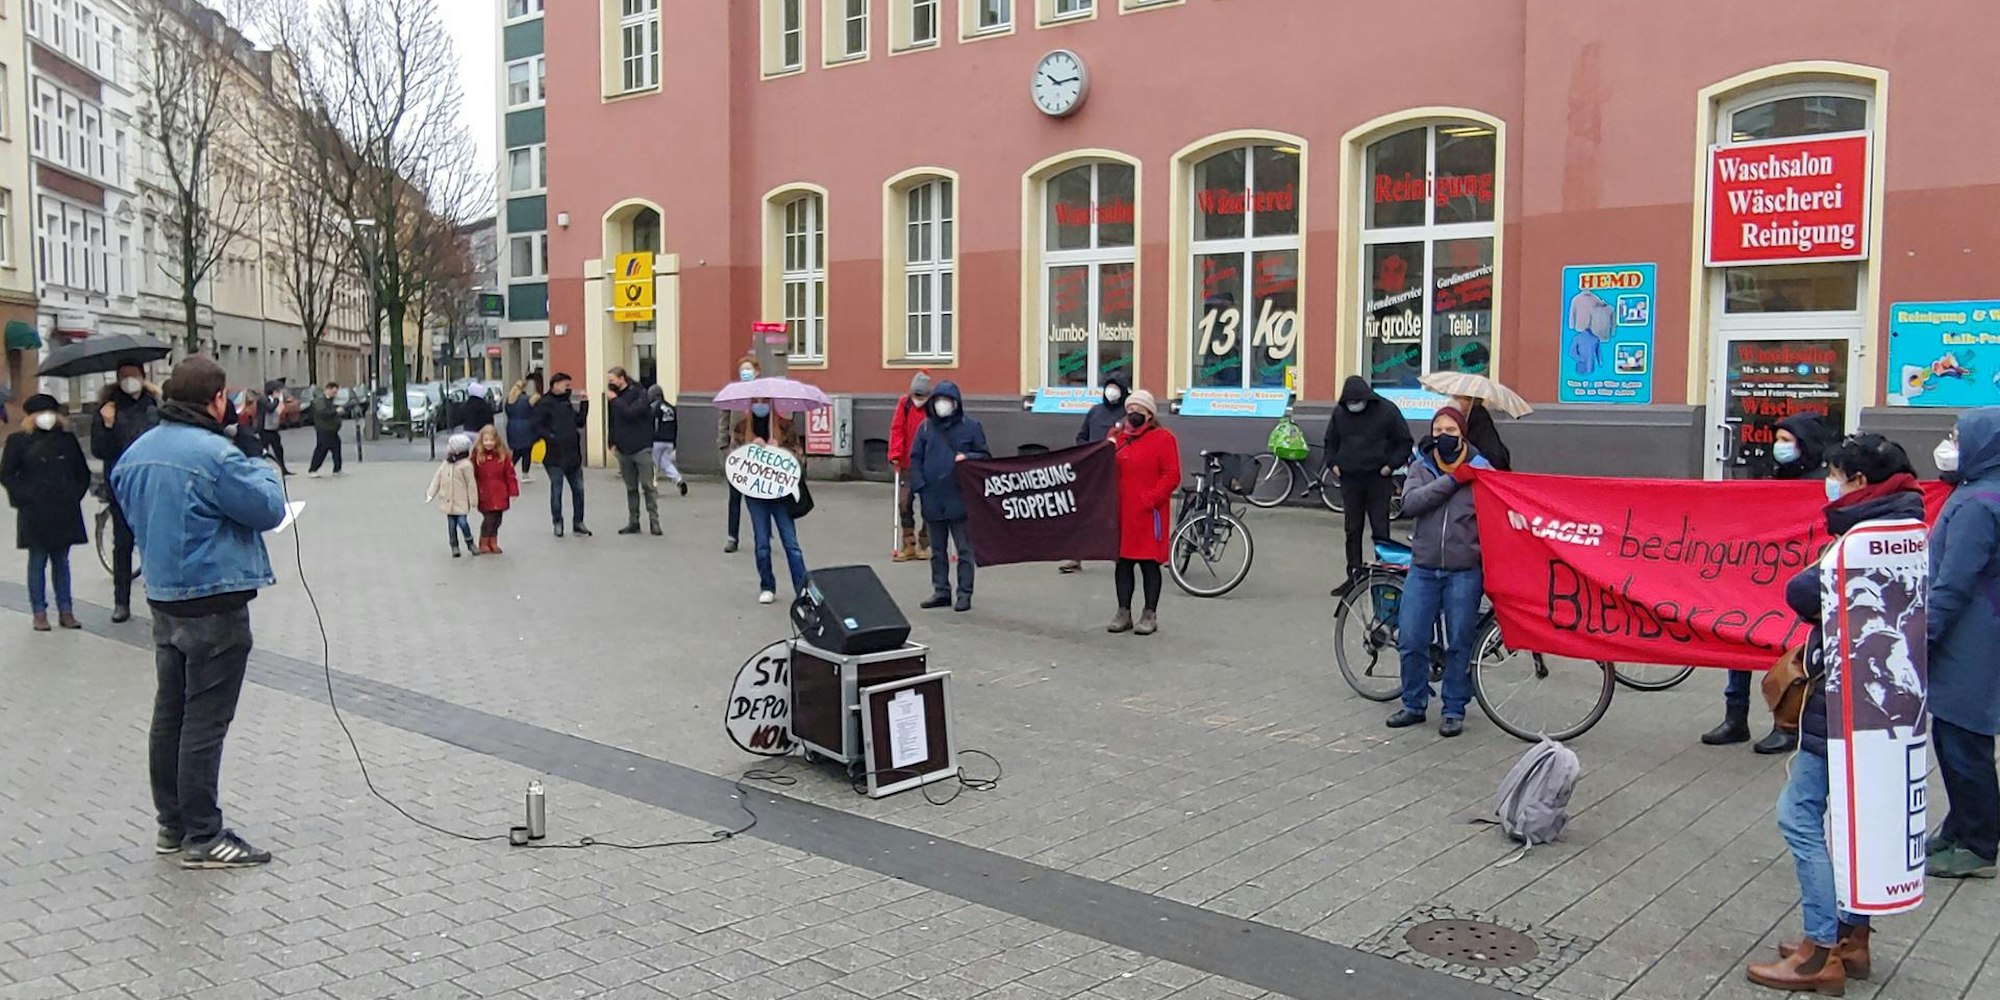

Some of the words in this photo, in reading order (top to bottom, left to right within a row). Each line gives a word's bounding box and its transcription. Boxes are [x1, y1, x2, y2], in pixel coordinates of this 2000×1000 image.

[1718, 152, 1833, 183] Waschsalon
[1374, 171, 1493, 208] Reinigung
[1727, 183, 1843, 215] Wäscherei
[1741, 220, 1856, 252] Reinigung
[1436, 264, 1493, 289] Gardinenservice
[1580, 272, 1642, 289] HEMD
[1366, 286, 1422, 313] Hemdenservice
[1049, 323, 1089, 342] Jumbo-
[1198, 308, 1241, 356] 13
[1252, 298, 1298, 360] kg
[1365, 315, 1381, 338] für
[1381, 309, 1421, 344] große
[1448, 313, 1473, 337] Teile
[812, 415, 828, 432] 24
[728, 456, 741, 466] OF
[740, 459, 799, 488] MOVEMENT
[747, 445, 798, 475] FREEDOM
[732, 473, 748, 486] FOR
[749, 478, 773, 495] ALL
[984, 462, 1076, 497] ABSCHIEBUNG
[1002, 489, 1077, 519] STOPPEN!
[1531, 516, 1604, 546] LAGER
[1869, 538, 1926, 555] Bleibe
